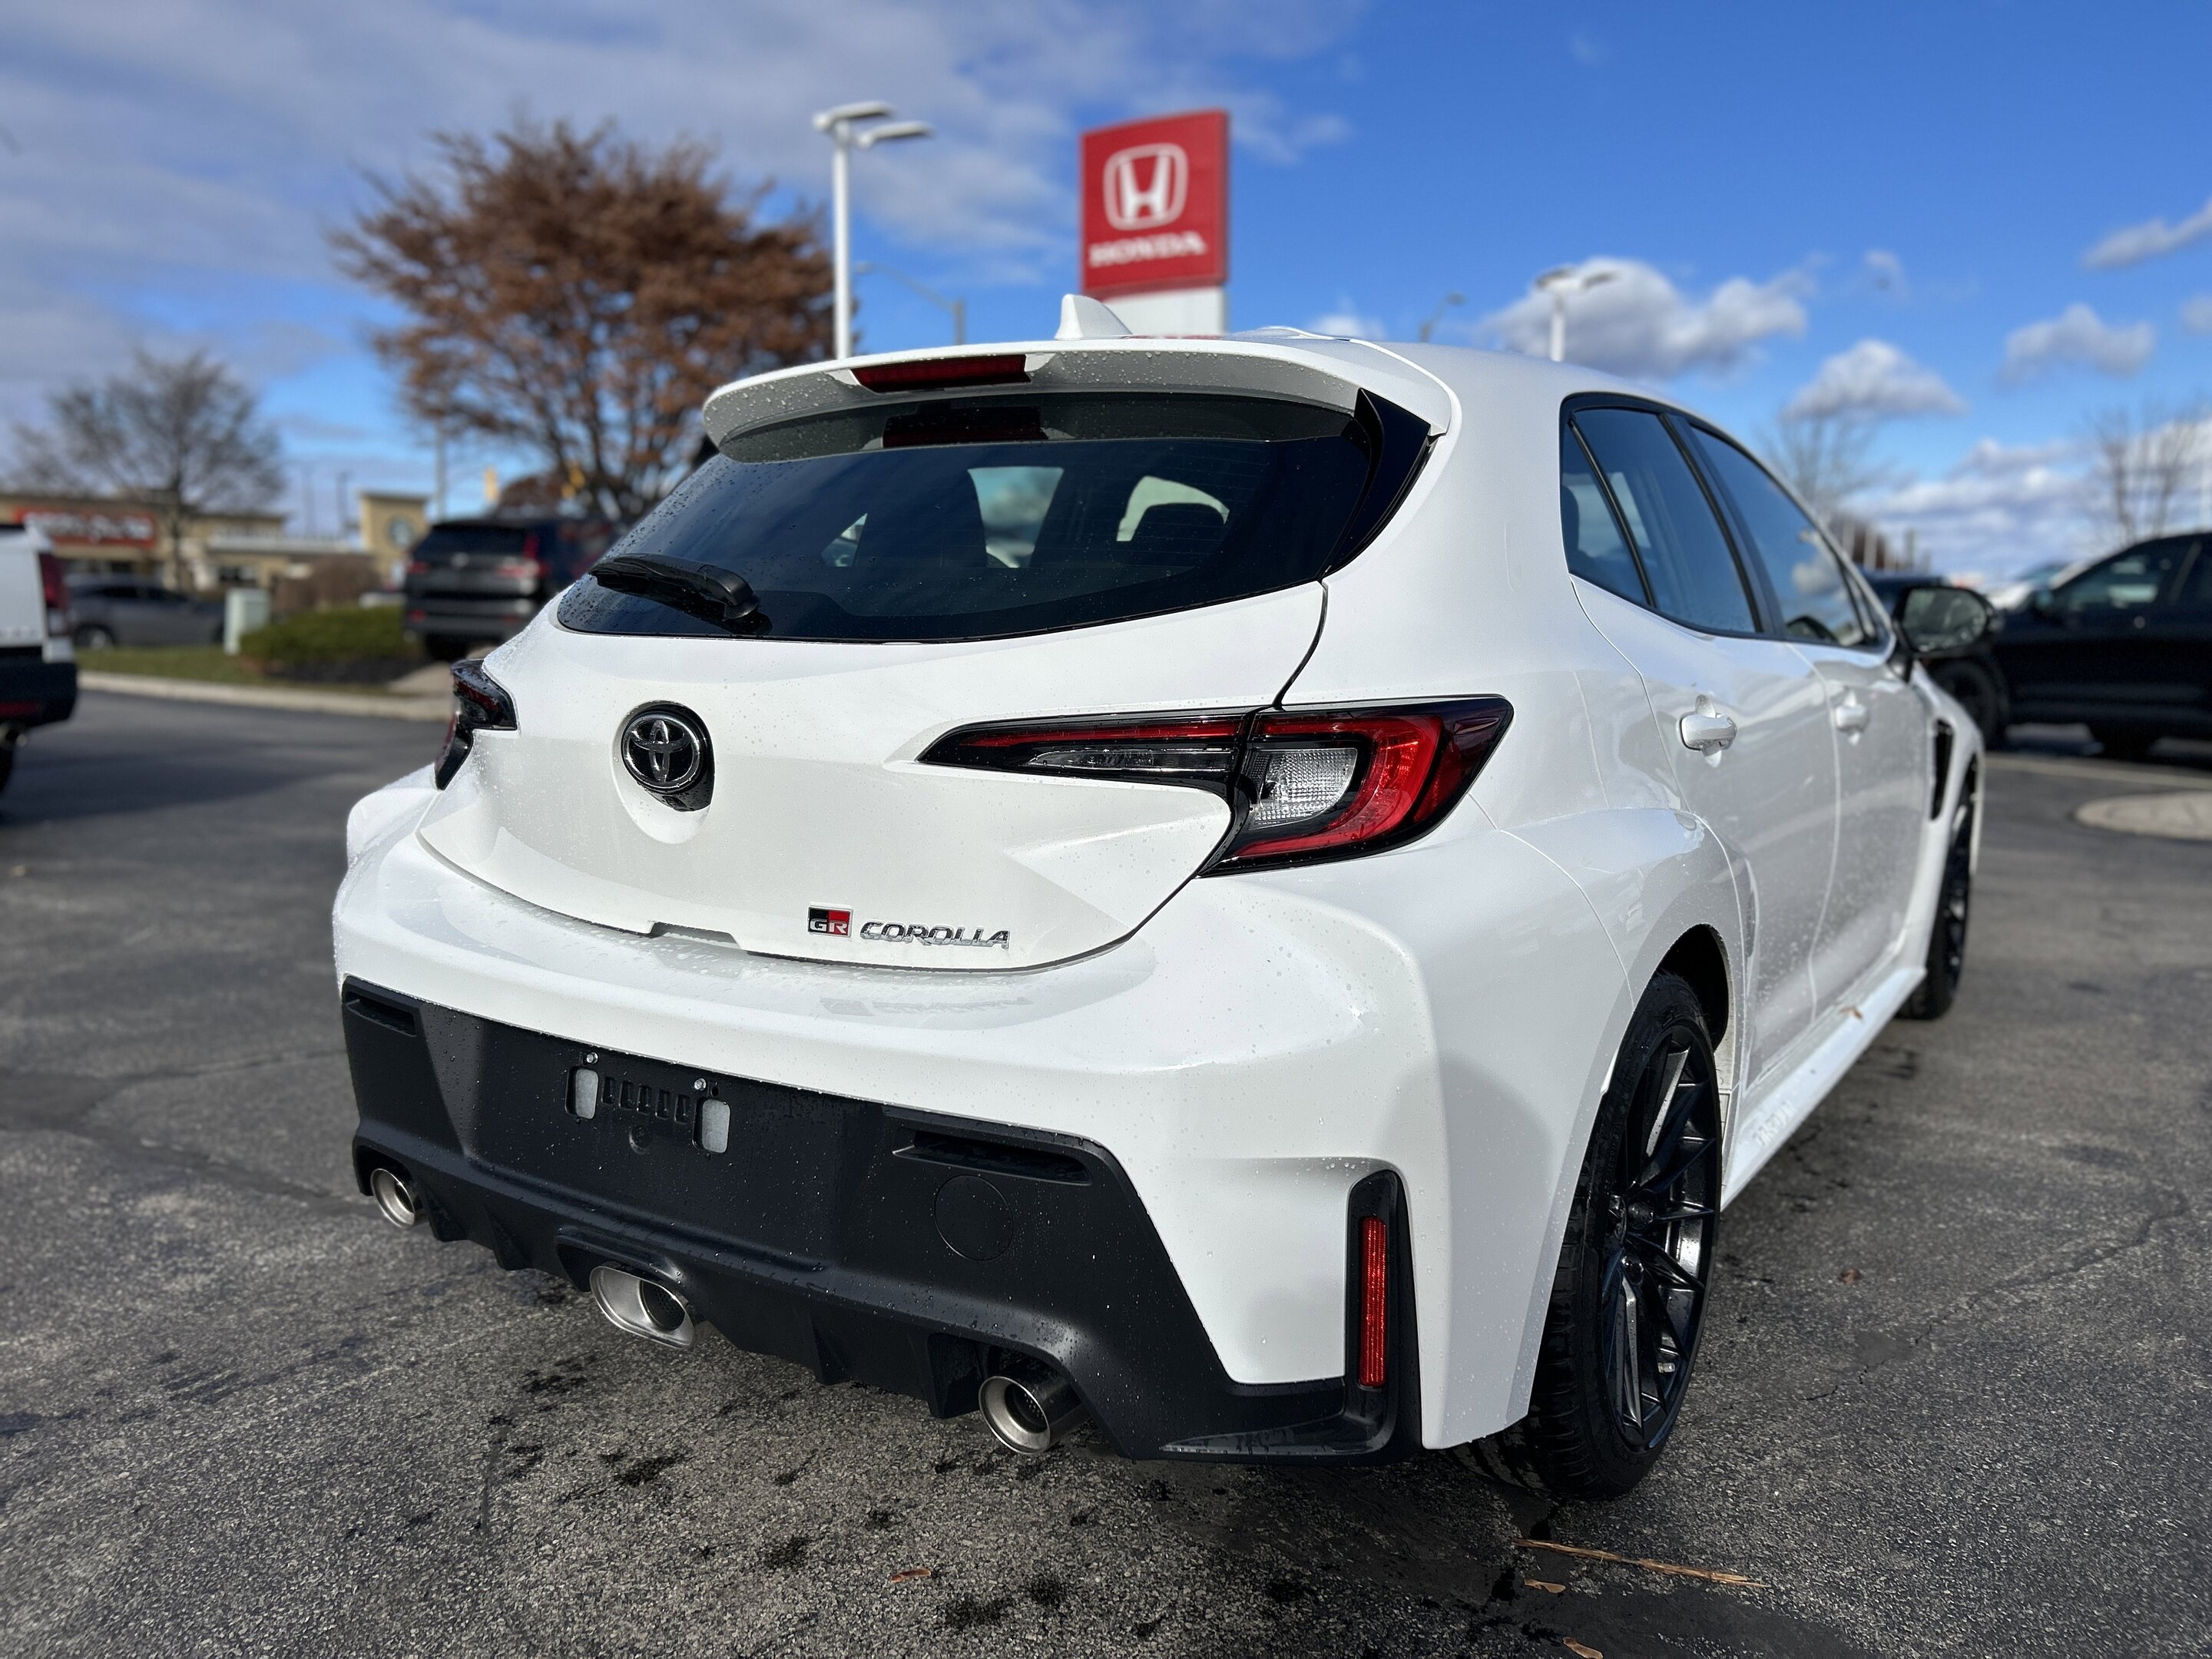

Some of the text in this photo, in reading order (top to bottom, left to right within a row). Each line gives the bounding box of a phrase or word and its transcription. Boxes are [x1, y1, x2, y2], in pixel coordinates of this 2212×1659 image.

[1089, 230, 1207, 267] HONDA
[810, 918, 1011, 951] GR COROLLA
